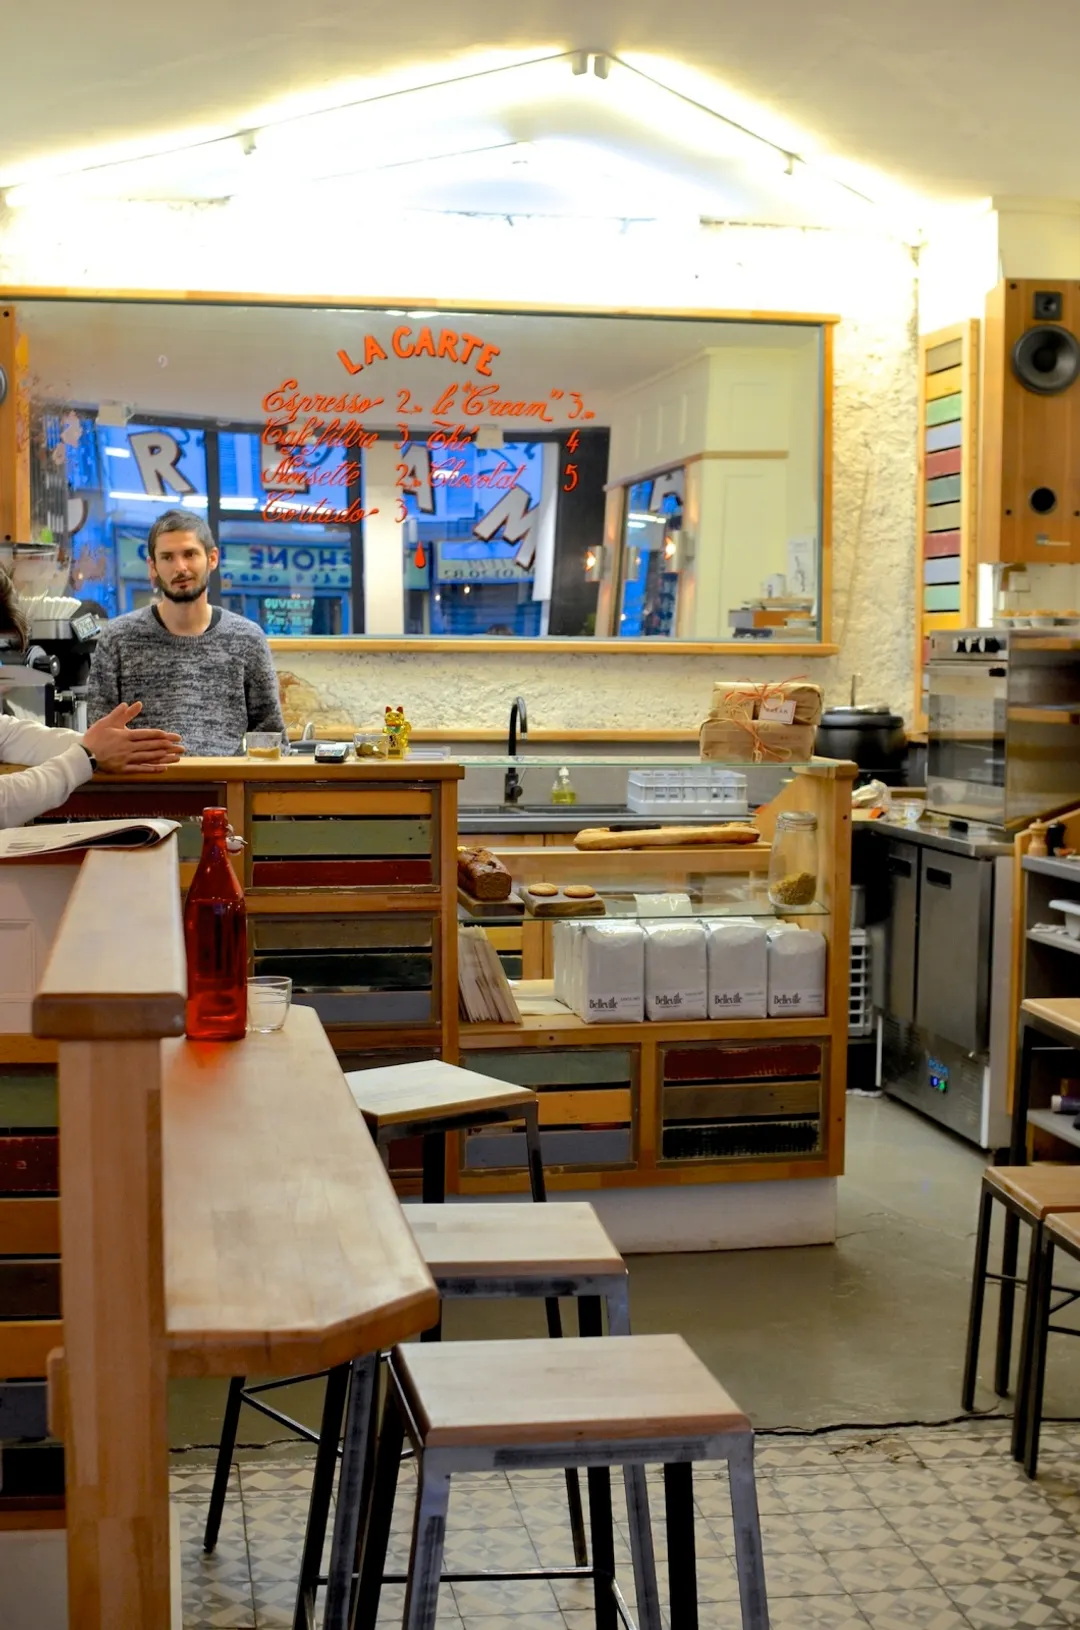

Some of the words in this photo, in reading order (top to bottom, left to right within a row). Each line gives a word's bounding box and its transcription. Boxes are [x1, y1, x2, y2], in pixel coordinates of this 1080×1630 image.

[336, 334, 388, 375] LA
[391, 325, 501, 377] CARTE
[262, 377, 385, 421] Espresso
[431, 382, 459, 415] le
[262, 417, 325, 456] Café
[301, 418, 379, 456] filtre
[426, 419, 480, 450] Thé
[566, 428, 580, 453] 4
[262, 454, 360, 487] Noisette
[428, 456, 527, 489] Chocolat
[564, 464, 578, 493] 5
[262, 488, 379, 524] Cortado
